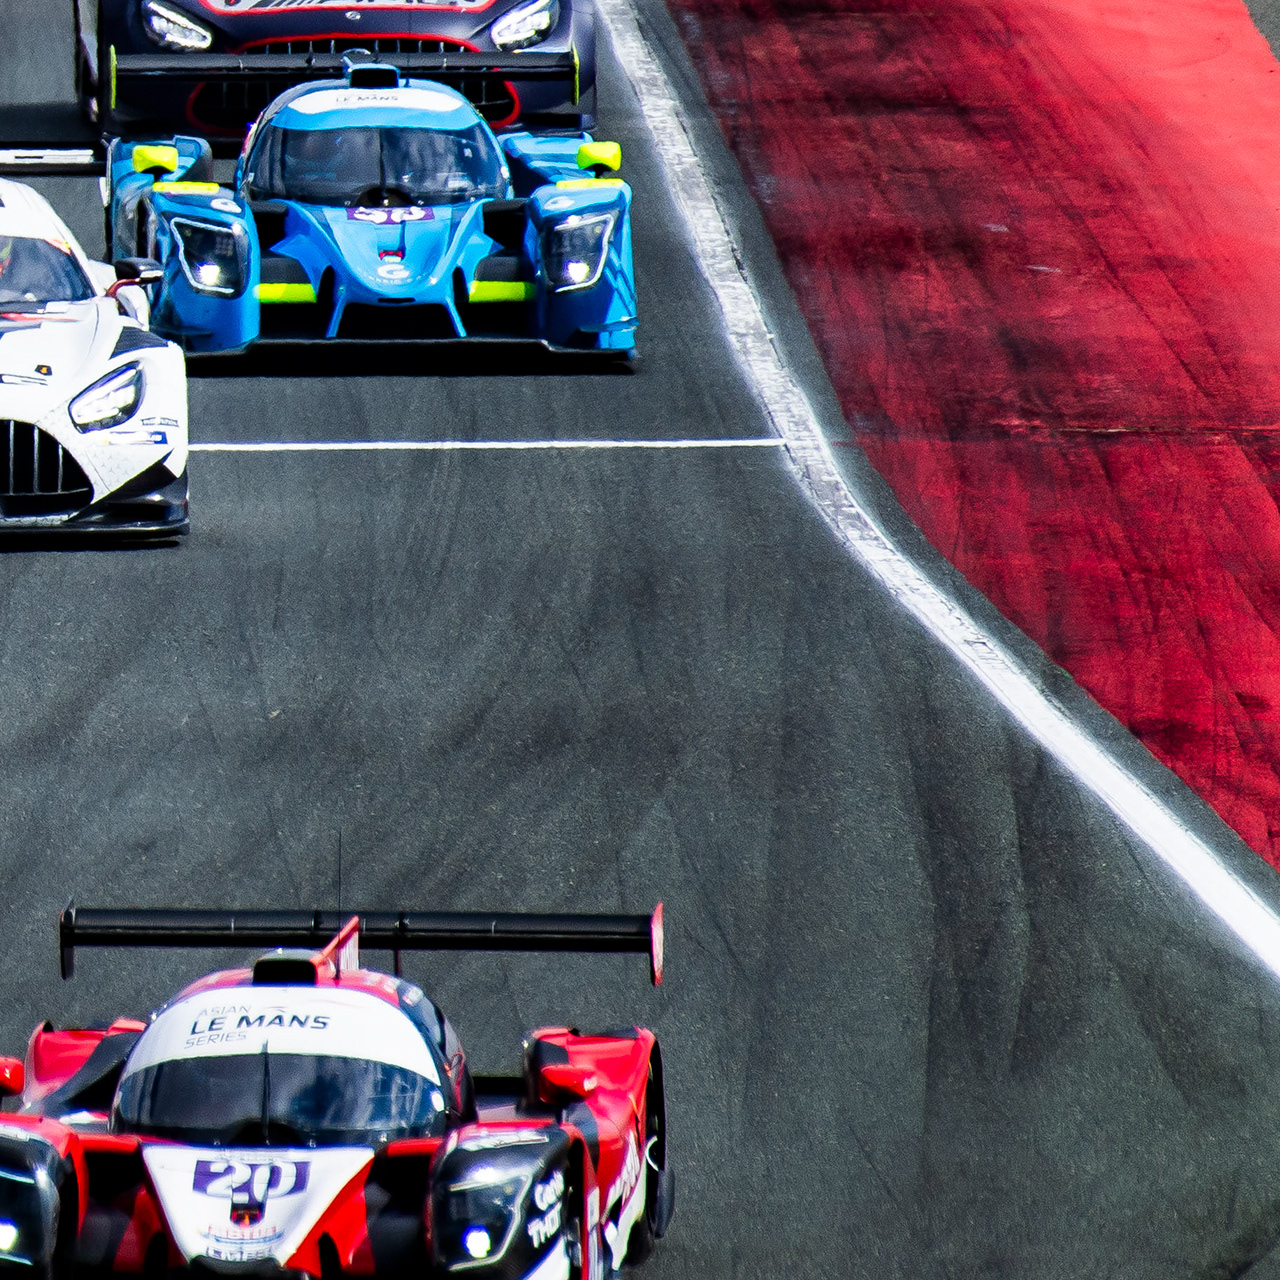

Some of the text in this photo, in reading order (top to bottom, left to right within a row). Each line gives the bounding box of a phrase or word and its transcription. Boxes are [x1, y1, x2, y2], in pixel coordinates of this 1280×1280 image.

[195, 1004, 252, 1020] ASIAN
[190, 1013, 331, 1036] LE MANS
[184, 1031, 248, 1050] SERIES
[206, 1160, 298, 1204] 20
